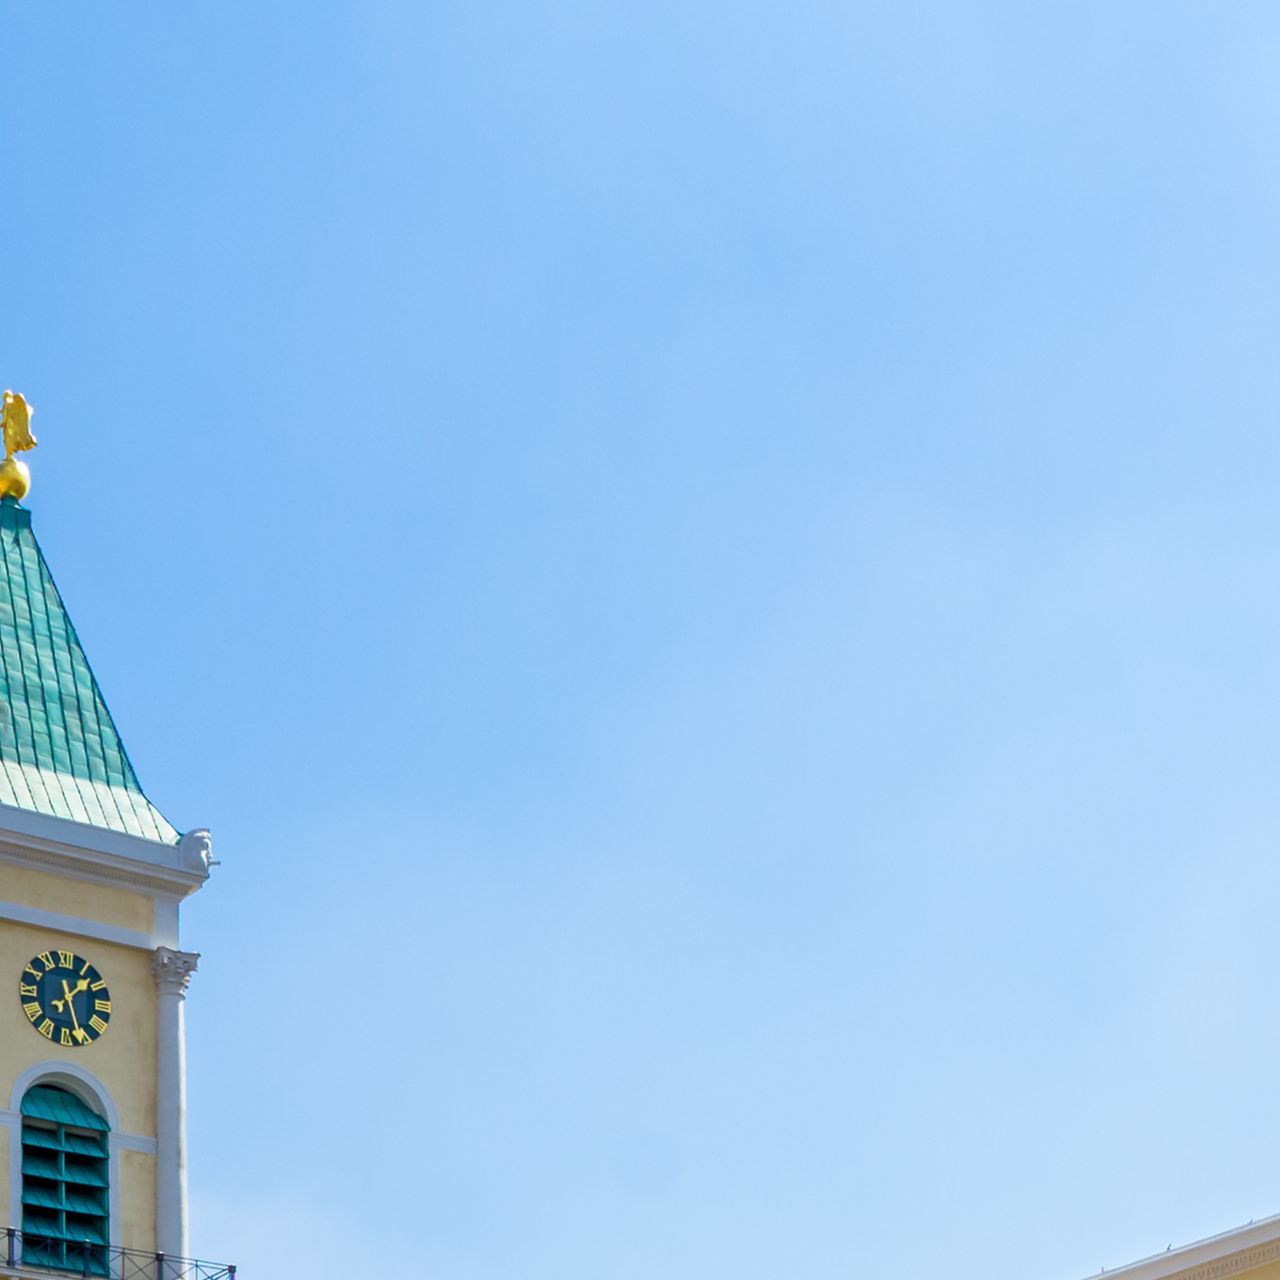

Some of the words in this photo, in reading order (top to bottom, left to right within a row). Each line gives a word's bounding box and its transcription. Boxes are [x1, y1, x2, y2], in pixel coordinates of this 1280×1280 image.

[39, 951, 55, 970] XI
[57, 951, 73, 969] XII
[81, 962, 90, 976] I
[26, 963, 42, 981] X
[21, 982, 37, 997] IX
[90, 981, 106, 991] II
[24, 1002, 43, 1021] VIII
[95, 999, 112, 1014] III
[39, 1019, 54, 1039] VII
[89, 1015, 108, 1034] IIII
[60, 1027, 73, 1046] VI
